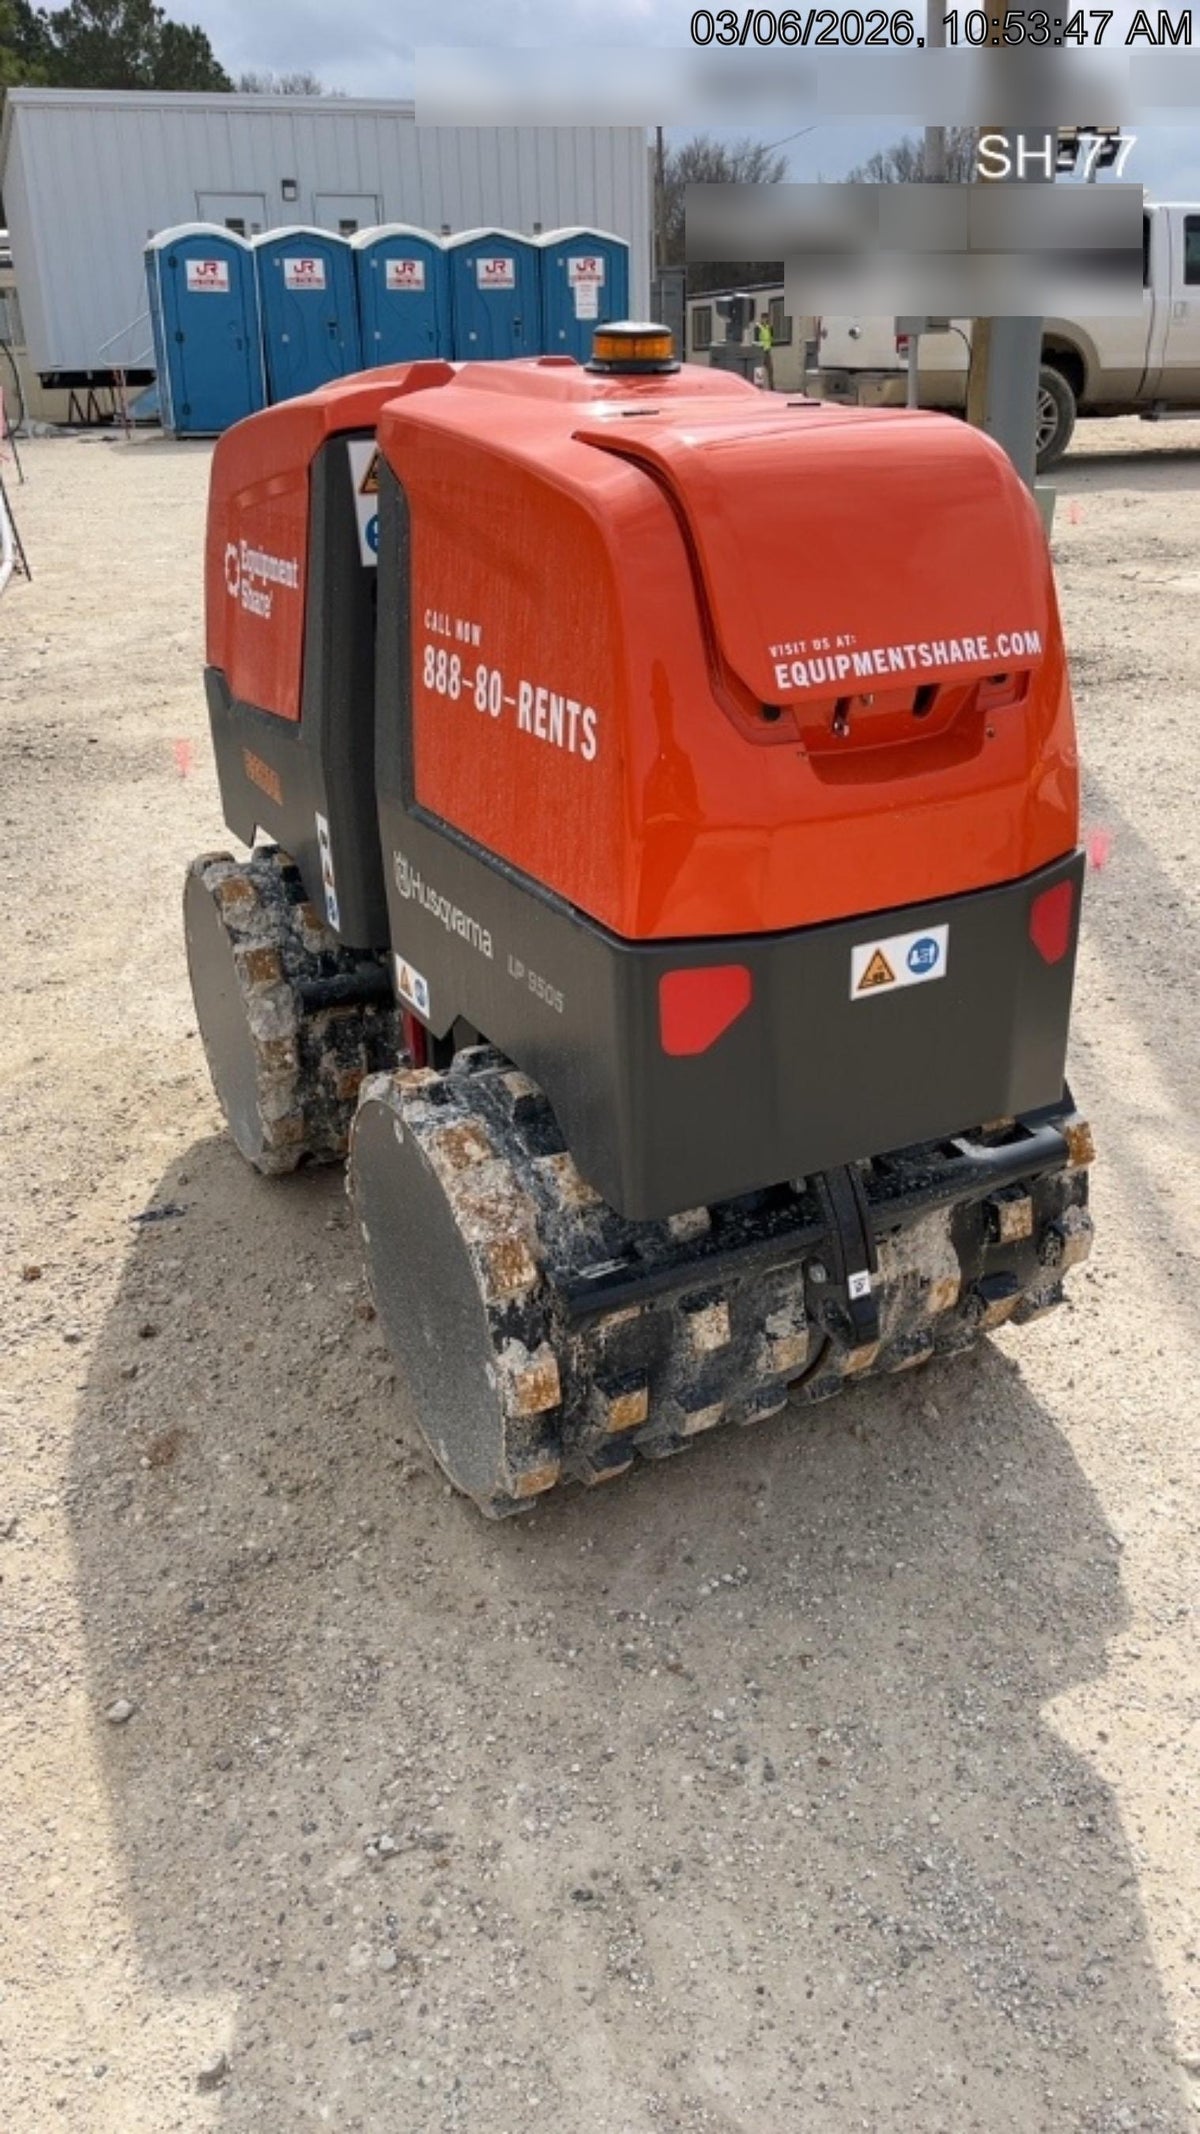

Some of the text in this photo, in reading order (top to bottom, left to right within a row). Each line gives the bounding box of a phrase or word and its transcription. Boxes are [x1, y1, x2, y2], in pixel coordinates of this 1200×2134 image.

[196, 262, 217, 276] JR
[294, 260, 314, 273] JR
[395, 262, 416, 276] JR
[485, 260, 506, 273] JR
[576, 258, 596, 271] JR
[424, 608, 482, 647] CALL NOW
[769, 633, 856, 658] VISIT US AT:
[774, 630, 1042, 689] EQUIPMENTSHARE.COM
[423, 644, 597, 761] 888-80-RENTS
[410, 866, 494, 960] Husqvarna
